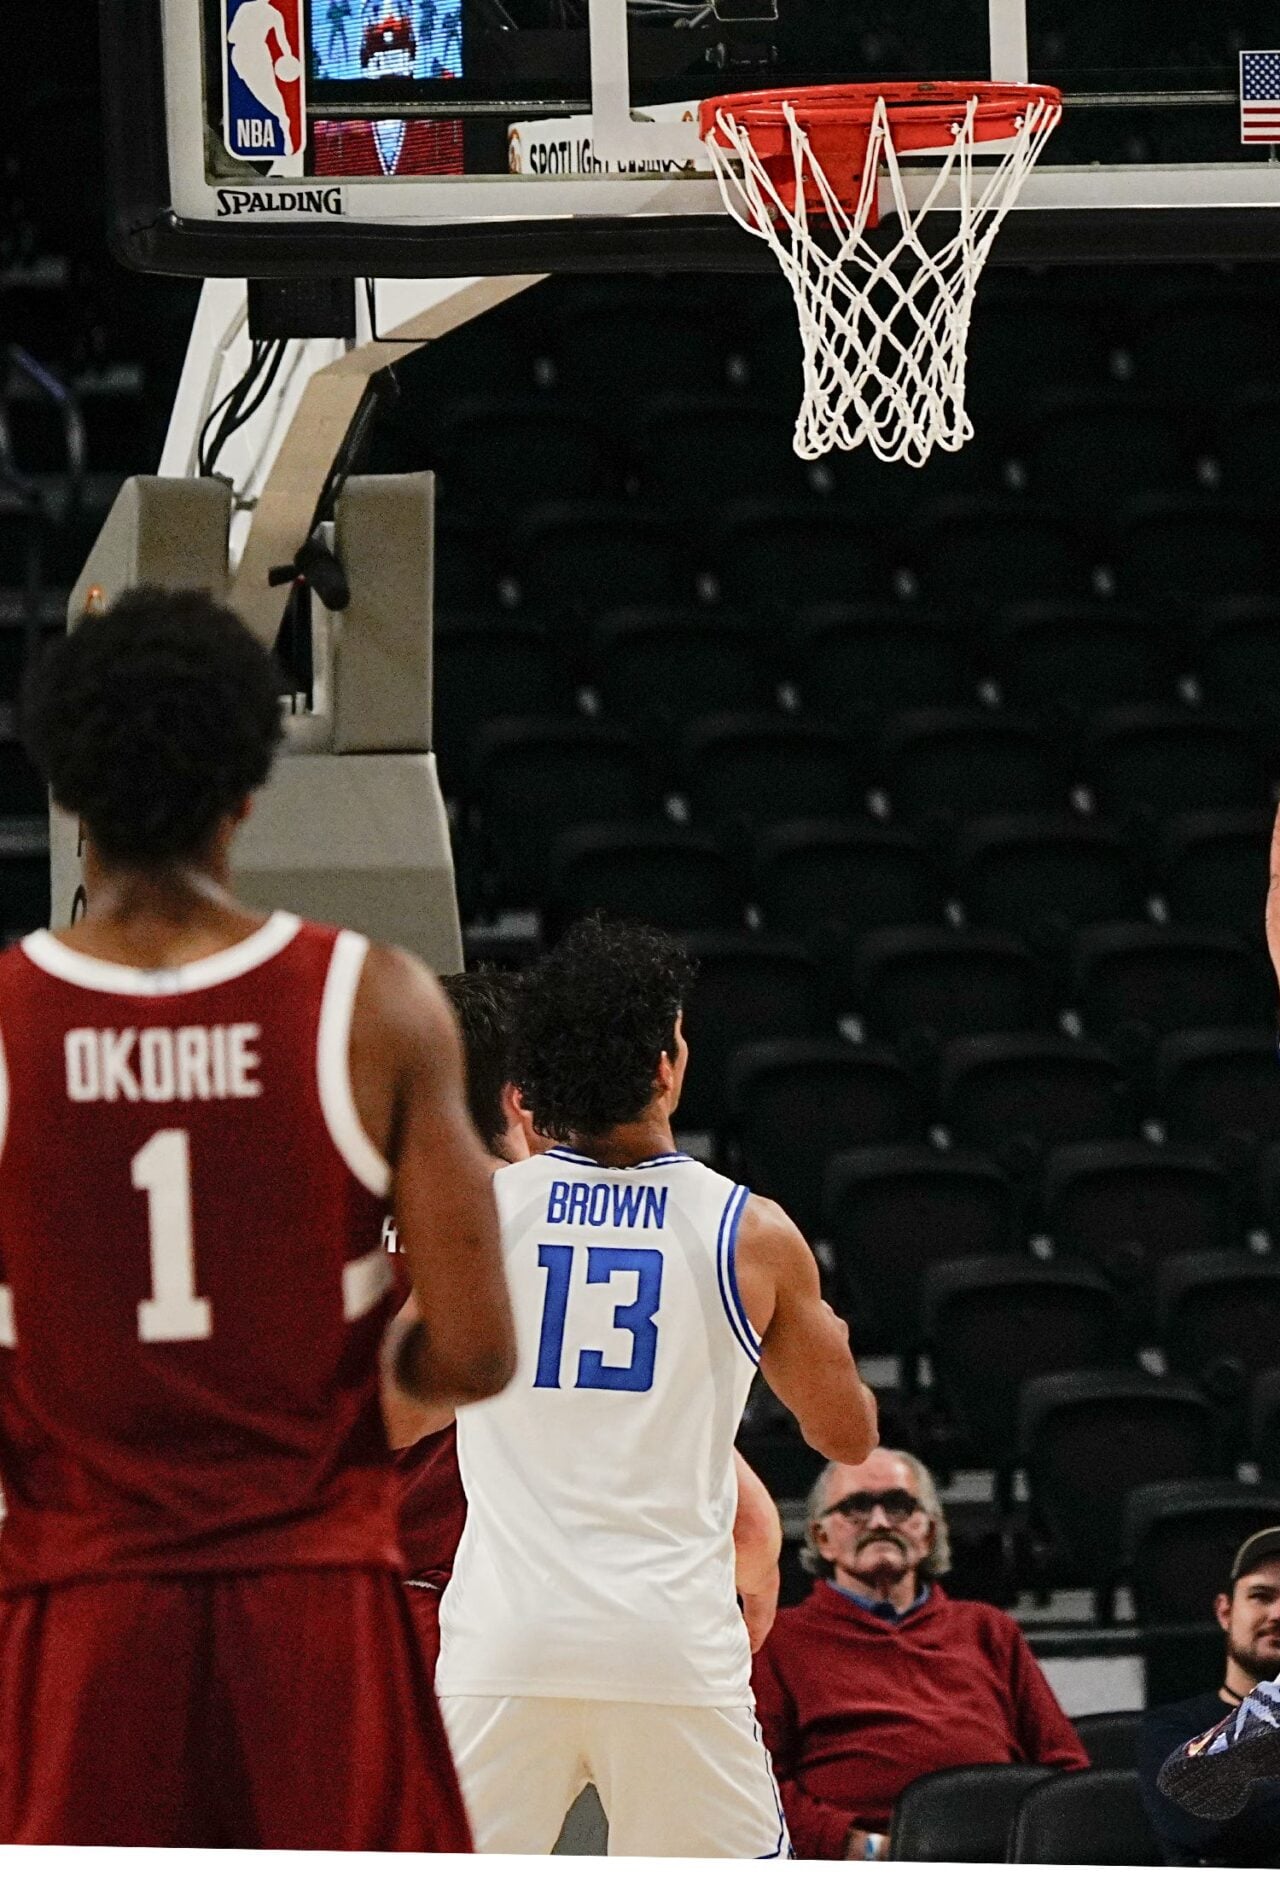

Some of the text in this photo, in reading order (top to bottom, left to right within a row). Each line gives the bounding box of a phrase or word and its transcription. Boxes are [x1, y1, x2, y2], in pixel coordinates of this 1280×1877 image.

[237, 118, 275, 148] NBA
[217, 187, 342, 217] SPALDING
[64, 1022, 263, 1102] OKORIE
[129, 1126, 213, 1344] 1
[546, 1180, 669, 1230] BROWN
[532, 1243, 665, 1393] 13
